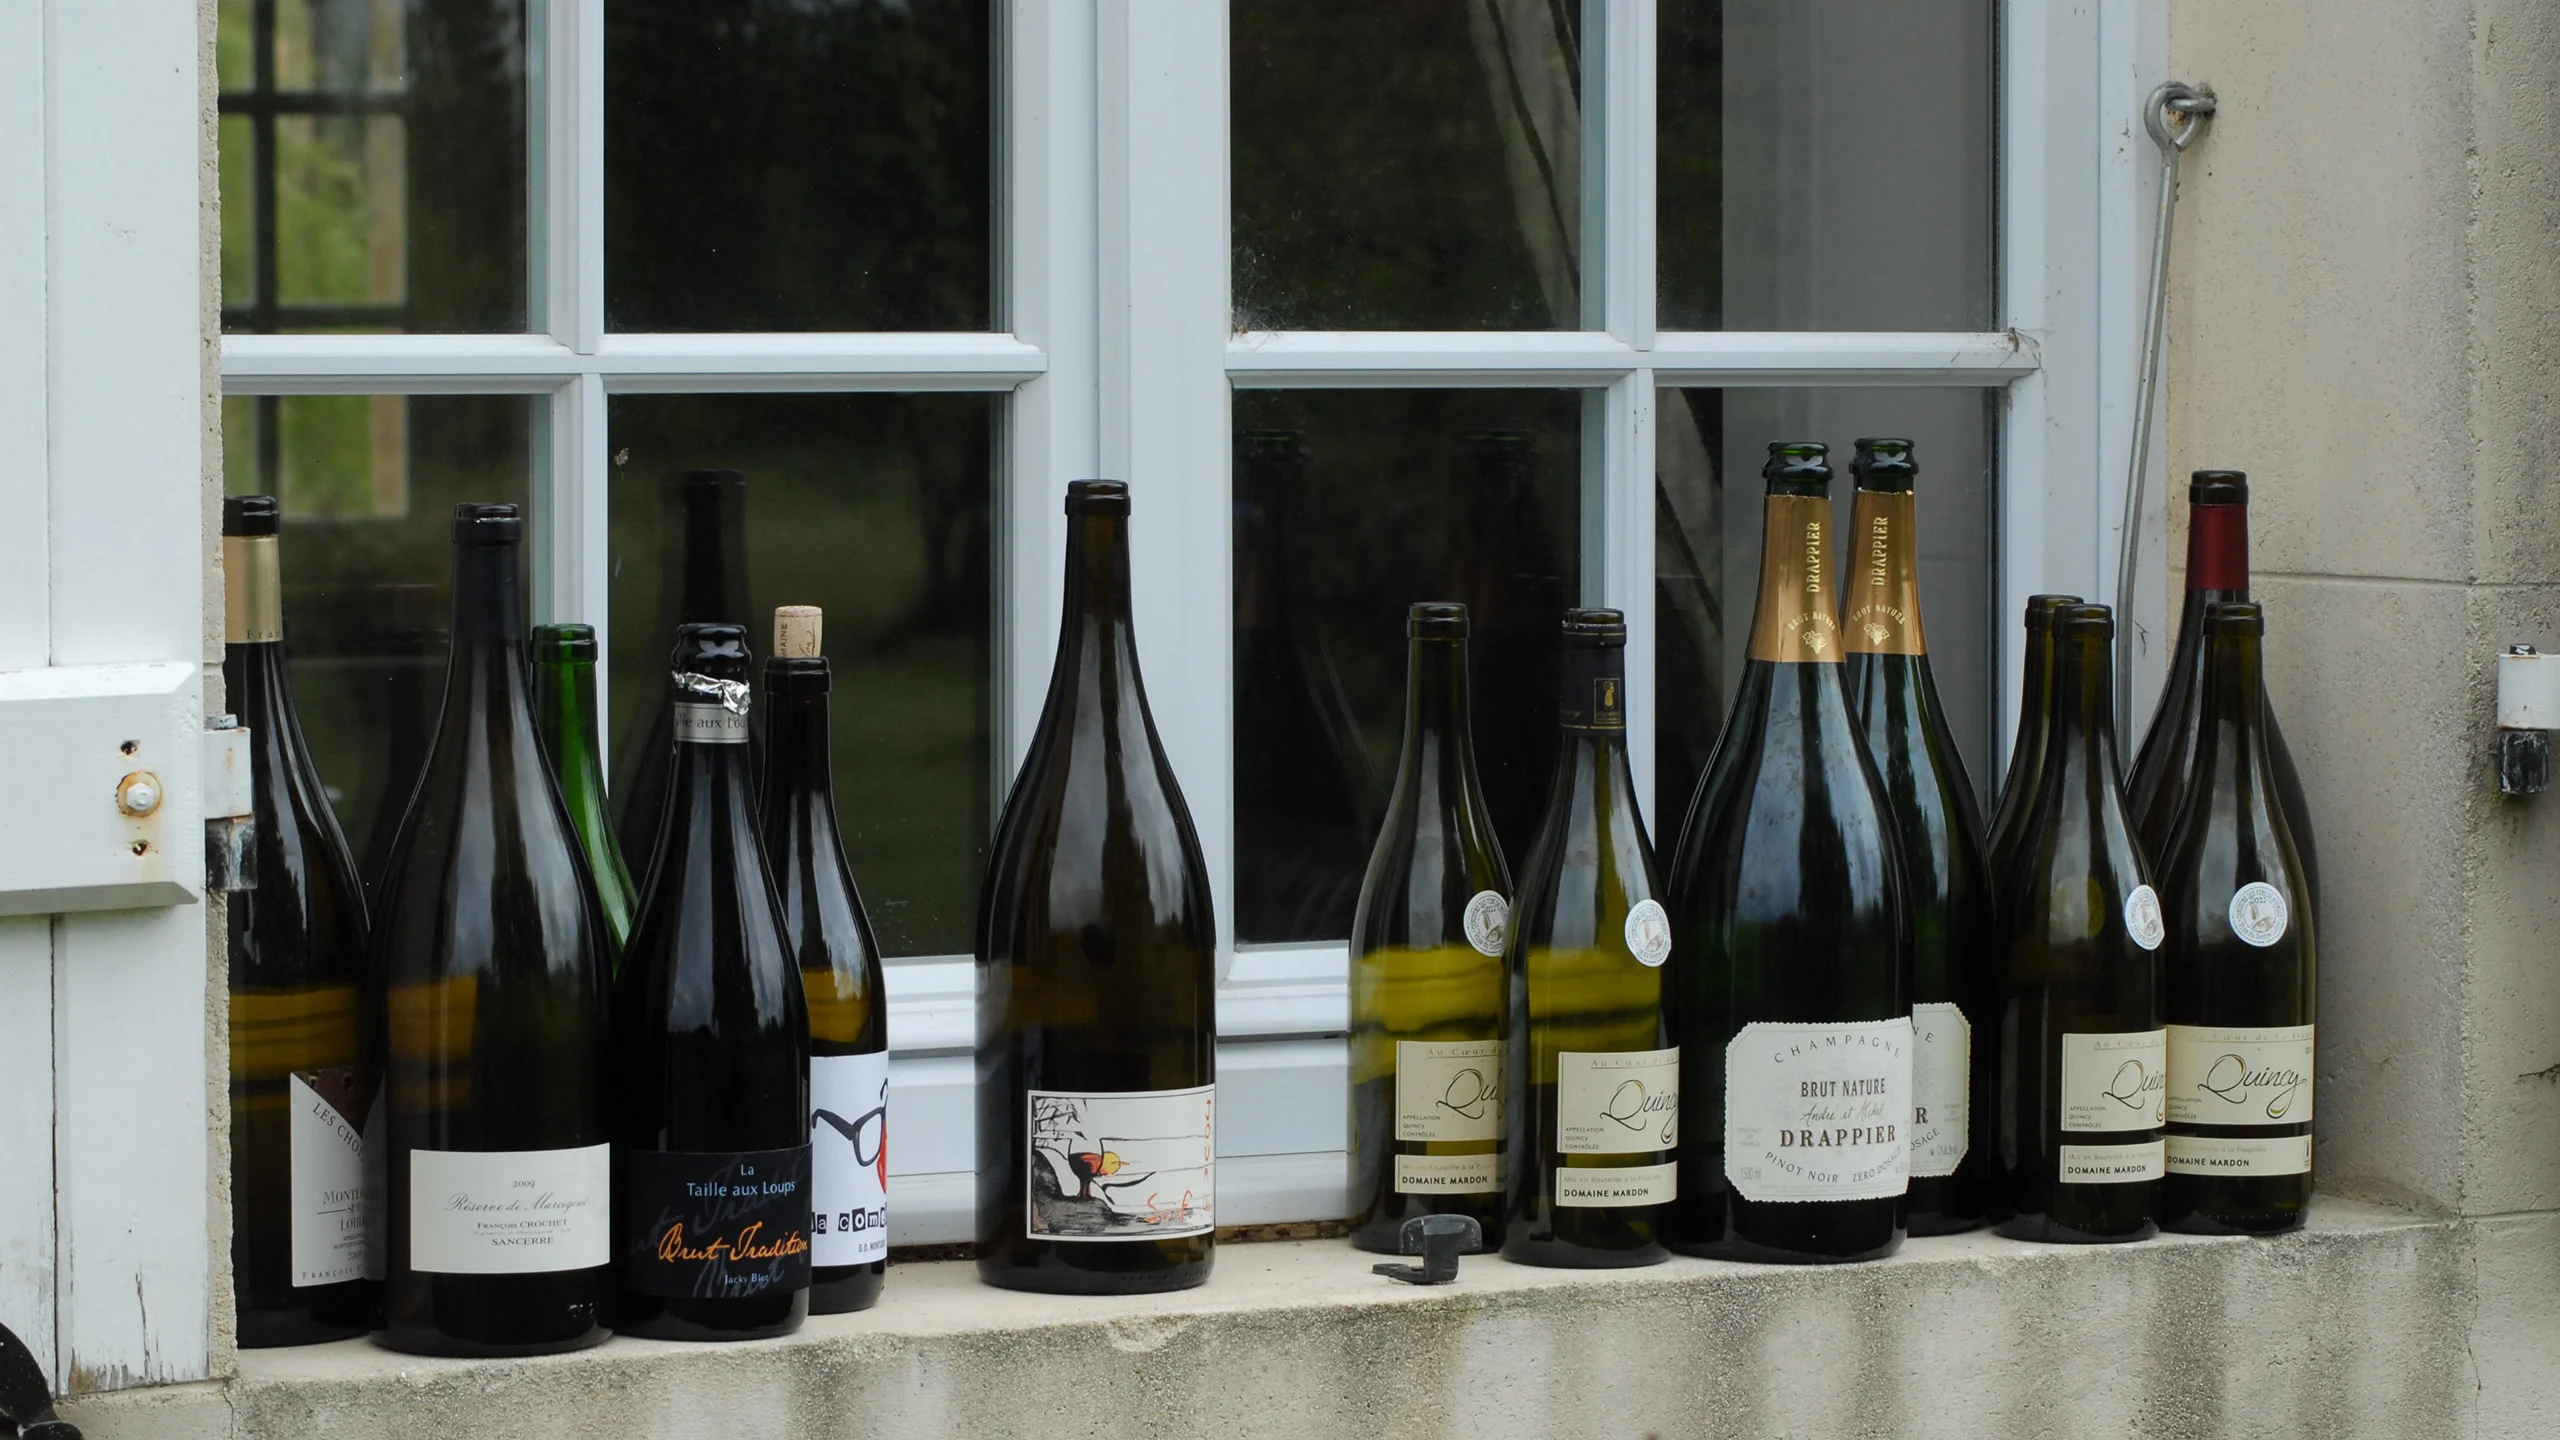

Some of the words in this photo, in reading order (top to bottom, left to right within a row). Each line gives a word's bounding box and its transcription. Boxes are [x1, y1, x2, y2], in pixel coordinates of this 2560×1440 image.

[1806, 521, 1820, 593] DRAPPIER
[1871, 516, 1888, 586] DRAPPIER
[1787, 613, 1809, 631] BRUT
[1852, 605, 1871, 622] BRUT
[1875, 604, 1906, 625] NATURE
[696, 717, 722, 729] aux
[727, 715, 746, 729] Lou
[1774, 1034, 1900, 1064] CHAMPAGNE
[1801, 1081, 1836, 1098] BRUT
[1842, 1078, 1886, 1097] NATURE
[2197, 1054, 2307, 1119] Quincy
[1839, 1104, 1857, 1120] et
[312, 1102, 335, 1126] LES
[337, 1124, 364, 1163] CHOI
[1780, 1124, 1896, 1148] DRAPPIER
[1910, 1127, 1940, 1151] OSAGE
[1764, 1151, 1803, 1176] PINOT
[1808, 1171, 1838, 1183] NOIR
[1852, 1168, 1876, 1183] ZERO
[2167, 1155, 2206, 1166] DOMAINE
[2210, 1158, 2250, 1167] MARDON
[741, 1164, 755, 1176] La
[2068, 1166, 2111, 1175] DOMAINE
[2114, 1165, 2146, 1174] MARDON
[512, 1180, 536, 1188] 2009
[1402, 1176, 1446, 1185] DOMAINE
[1450, 1175, 1488, 1185] MARDON
[323, 1187, 363, 1205] MONTL
[687, 1182, 727, 1197] Taille
[732, 1185, 758, 1195] aux
[763, 1181, 796, 1197] Loups
[1564, 1189, 1609, 1198] DOMAINE
[1613, 1188, 1649, 1197] MARDON
[505, 1199, 521, 1211] de
[519, 1218, 568, 1229] CROCHET
[491, 1236, 554, 1247] SANCERRE
[659, 1222, 731, 1263] Brut
[724, 1274, 748, 1287] Jacky
[751, 1272, 769, 1283] Blot
